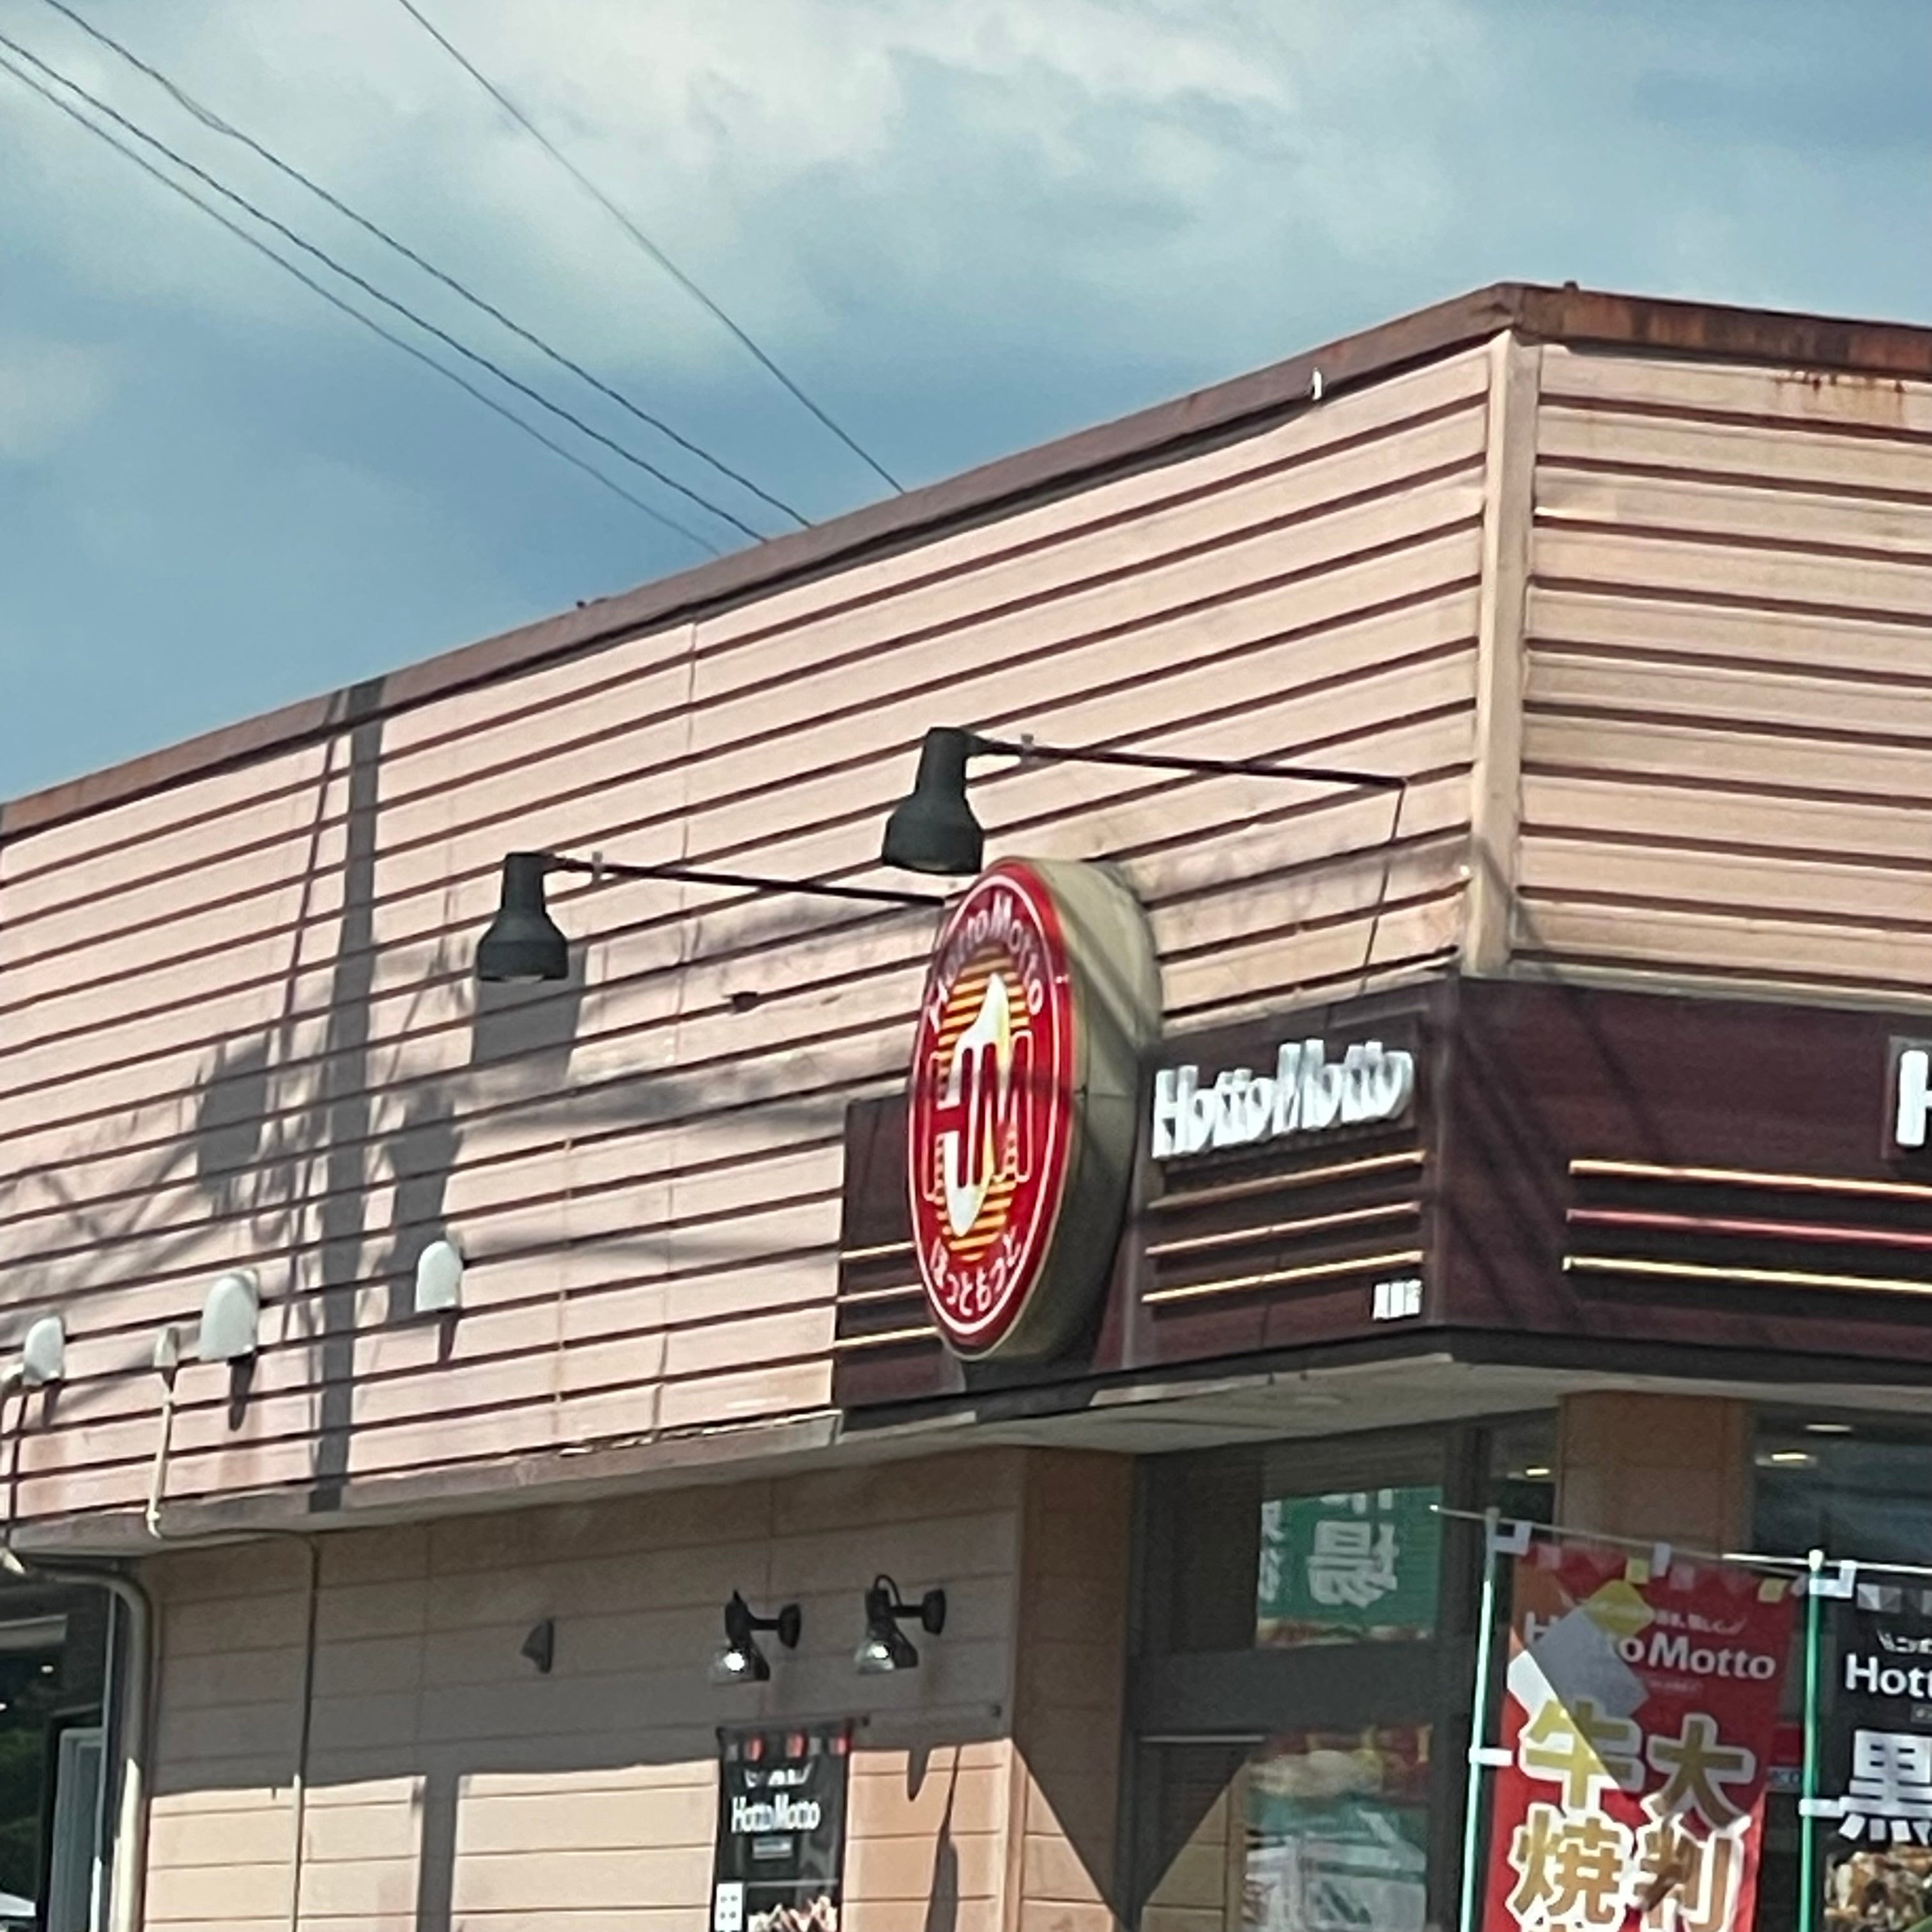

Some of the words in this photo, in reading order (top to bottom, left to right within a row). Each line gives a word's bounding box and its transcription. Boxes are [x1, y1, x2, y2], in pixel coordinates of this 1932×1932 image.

[1153, 1039, 1413, 1158] HottoMotto
[930, 1225, 1022, 1316] ほっともっと
[1524, 1611, 1776, 1680] HoMotto
[1509, 1698, 1642, 1932] 牛焼
[1636, 1713, 1754, 1932] 大判
[1838, 1729, 1932, 1846] 黒
